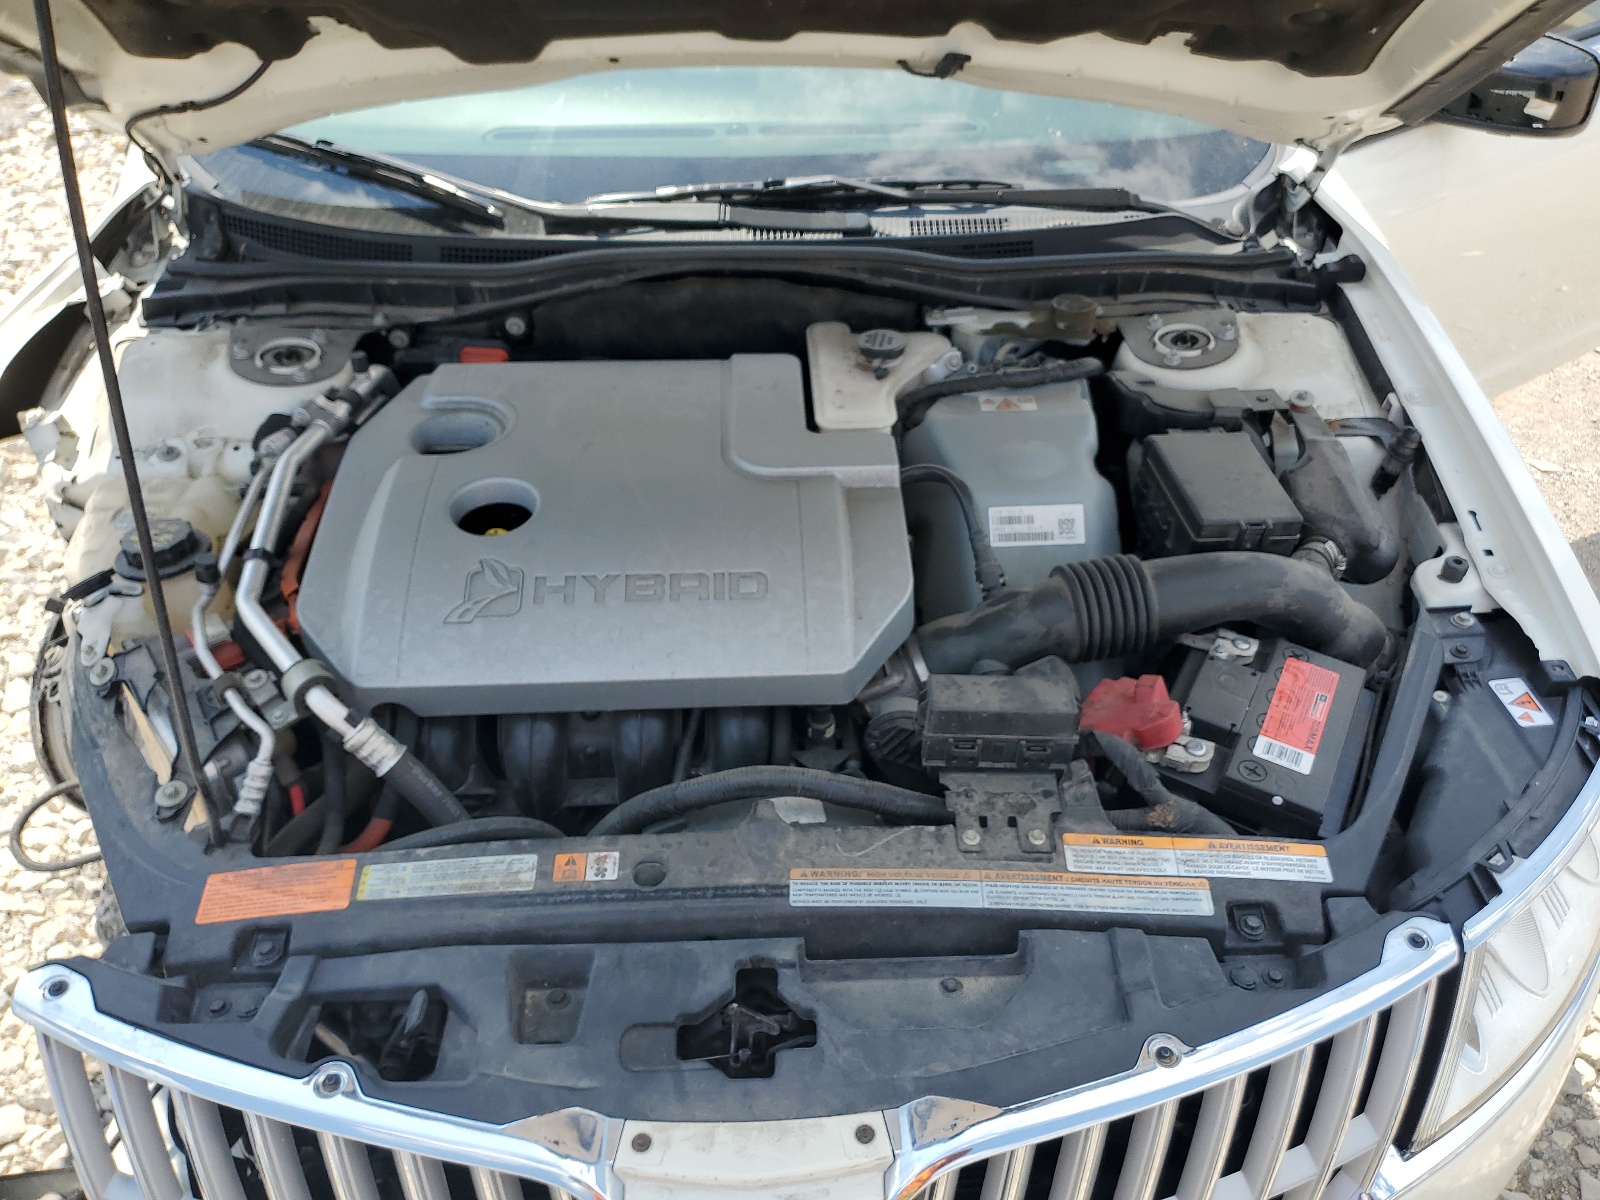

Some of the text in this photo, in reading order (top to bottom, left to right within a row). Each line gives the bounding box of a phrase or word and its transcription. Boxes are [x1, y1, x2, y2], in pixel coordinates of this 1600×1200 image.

[533, 571, 769, 604] HYBRID
[1103, 837, 1144, 846] WARNING
[1219, 842, 1290, 852] AVERTISSEMENT
[810, 870, 861, 878] WARNING:
[995, 872, 1064, 881] AVERTISSEMENT
